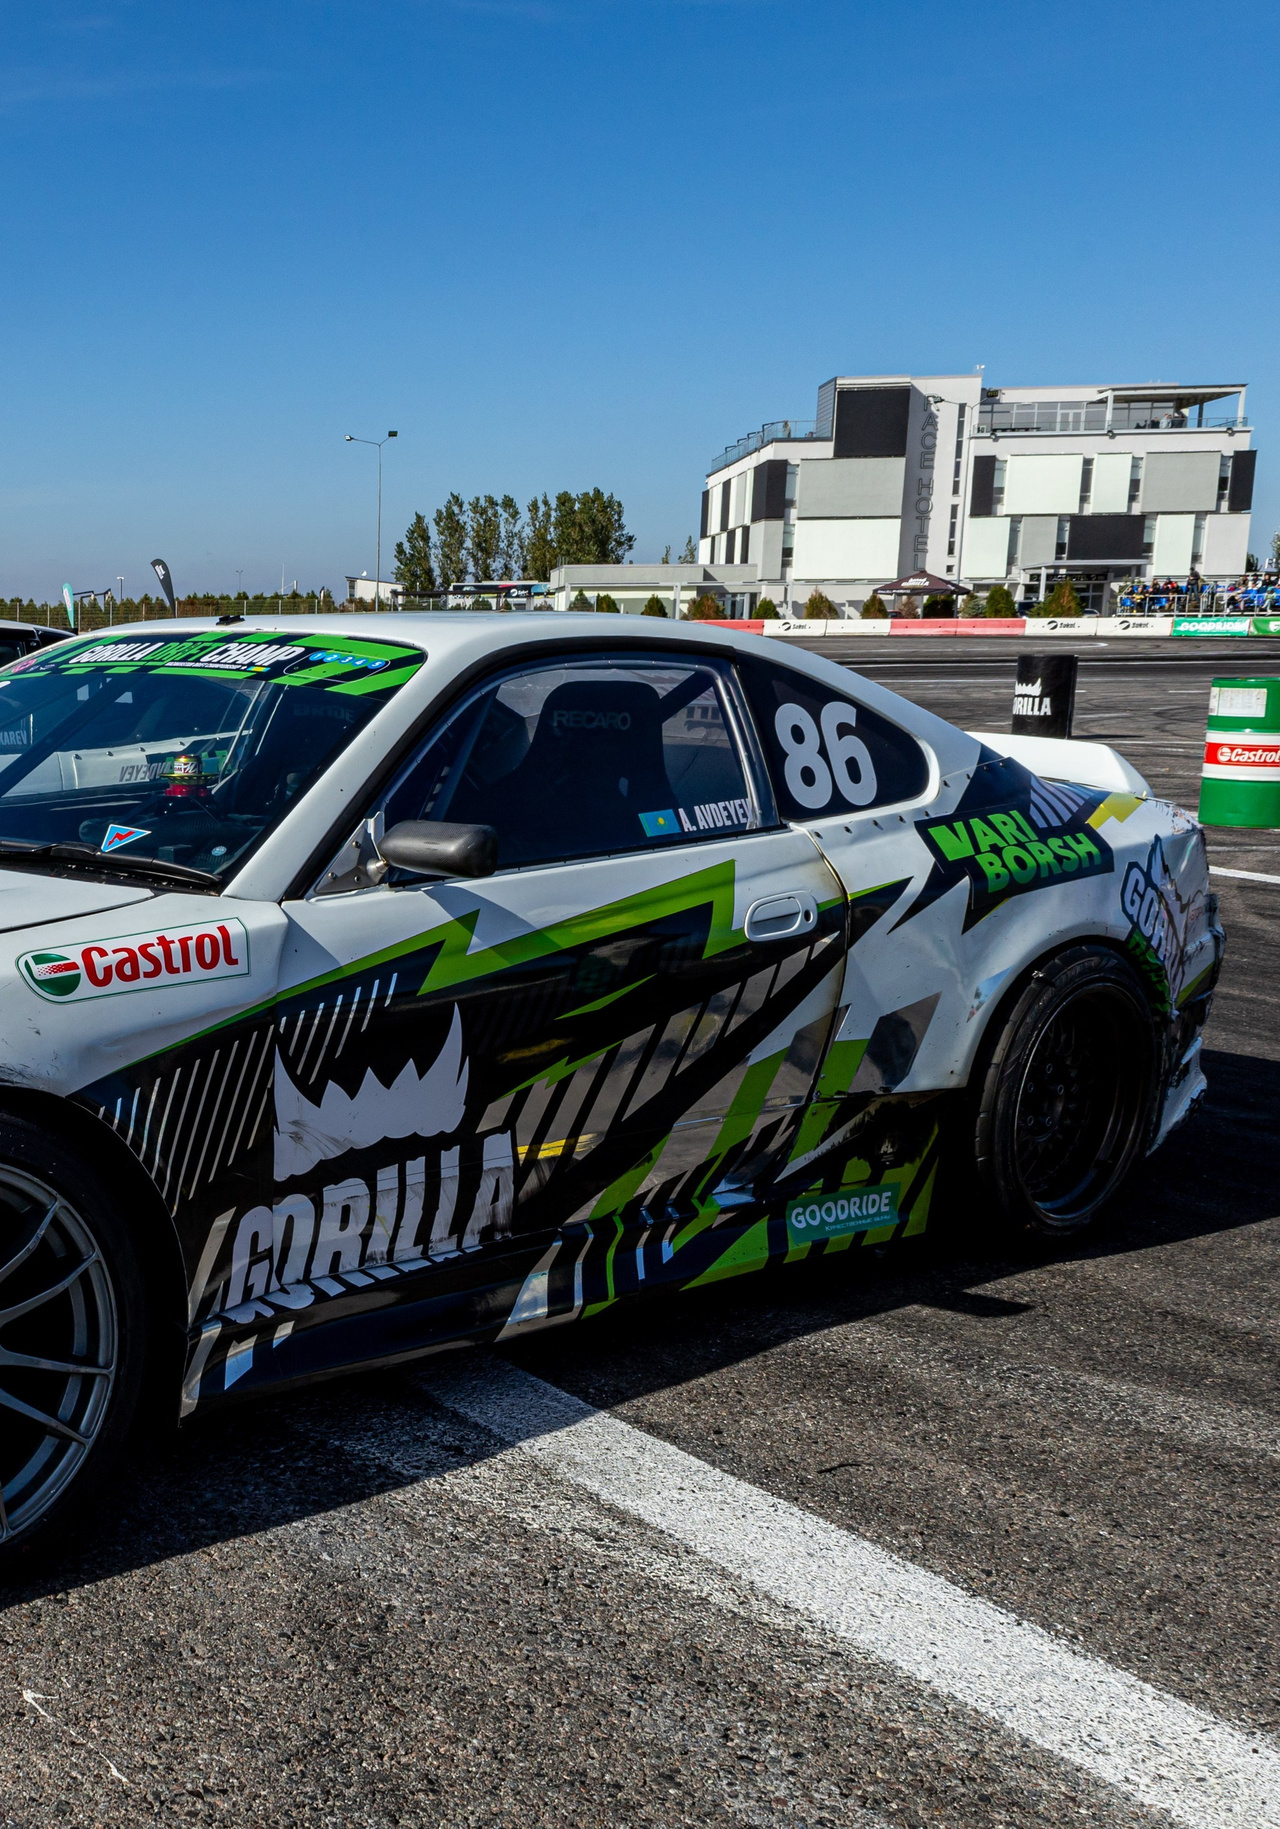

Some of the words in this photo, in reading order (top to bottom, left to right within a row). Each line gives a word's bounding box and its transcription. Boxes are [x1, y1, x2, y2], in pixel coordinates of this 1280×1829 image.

[920, 393, 939, 470] RACE
[913, 478, 934, 572] HOTEL
[69, 642, 166, 664] GORILLA
[200, 642, 306, 666] CHAMP
[553, 710, 631, 730] RECARO
[1013, 697, 1051, 716] ORILLA
[774, 700, 878, 810] 86
[1230, 748, 1280, 763] Castrol
[678, 808, 697, 832] A.
[974, 833, 1102, 893] BORSH
[81, 925, 239, 987] Castrol
[221, 1130, 515, 1324] GORILLA
[791, 1191, 892, 1229] GOODRIDE
